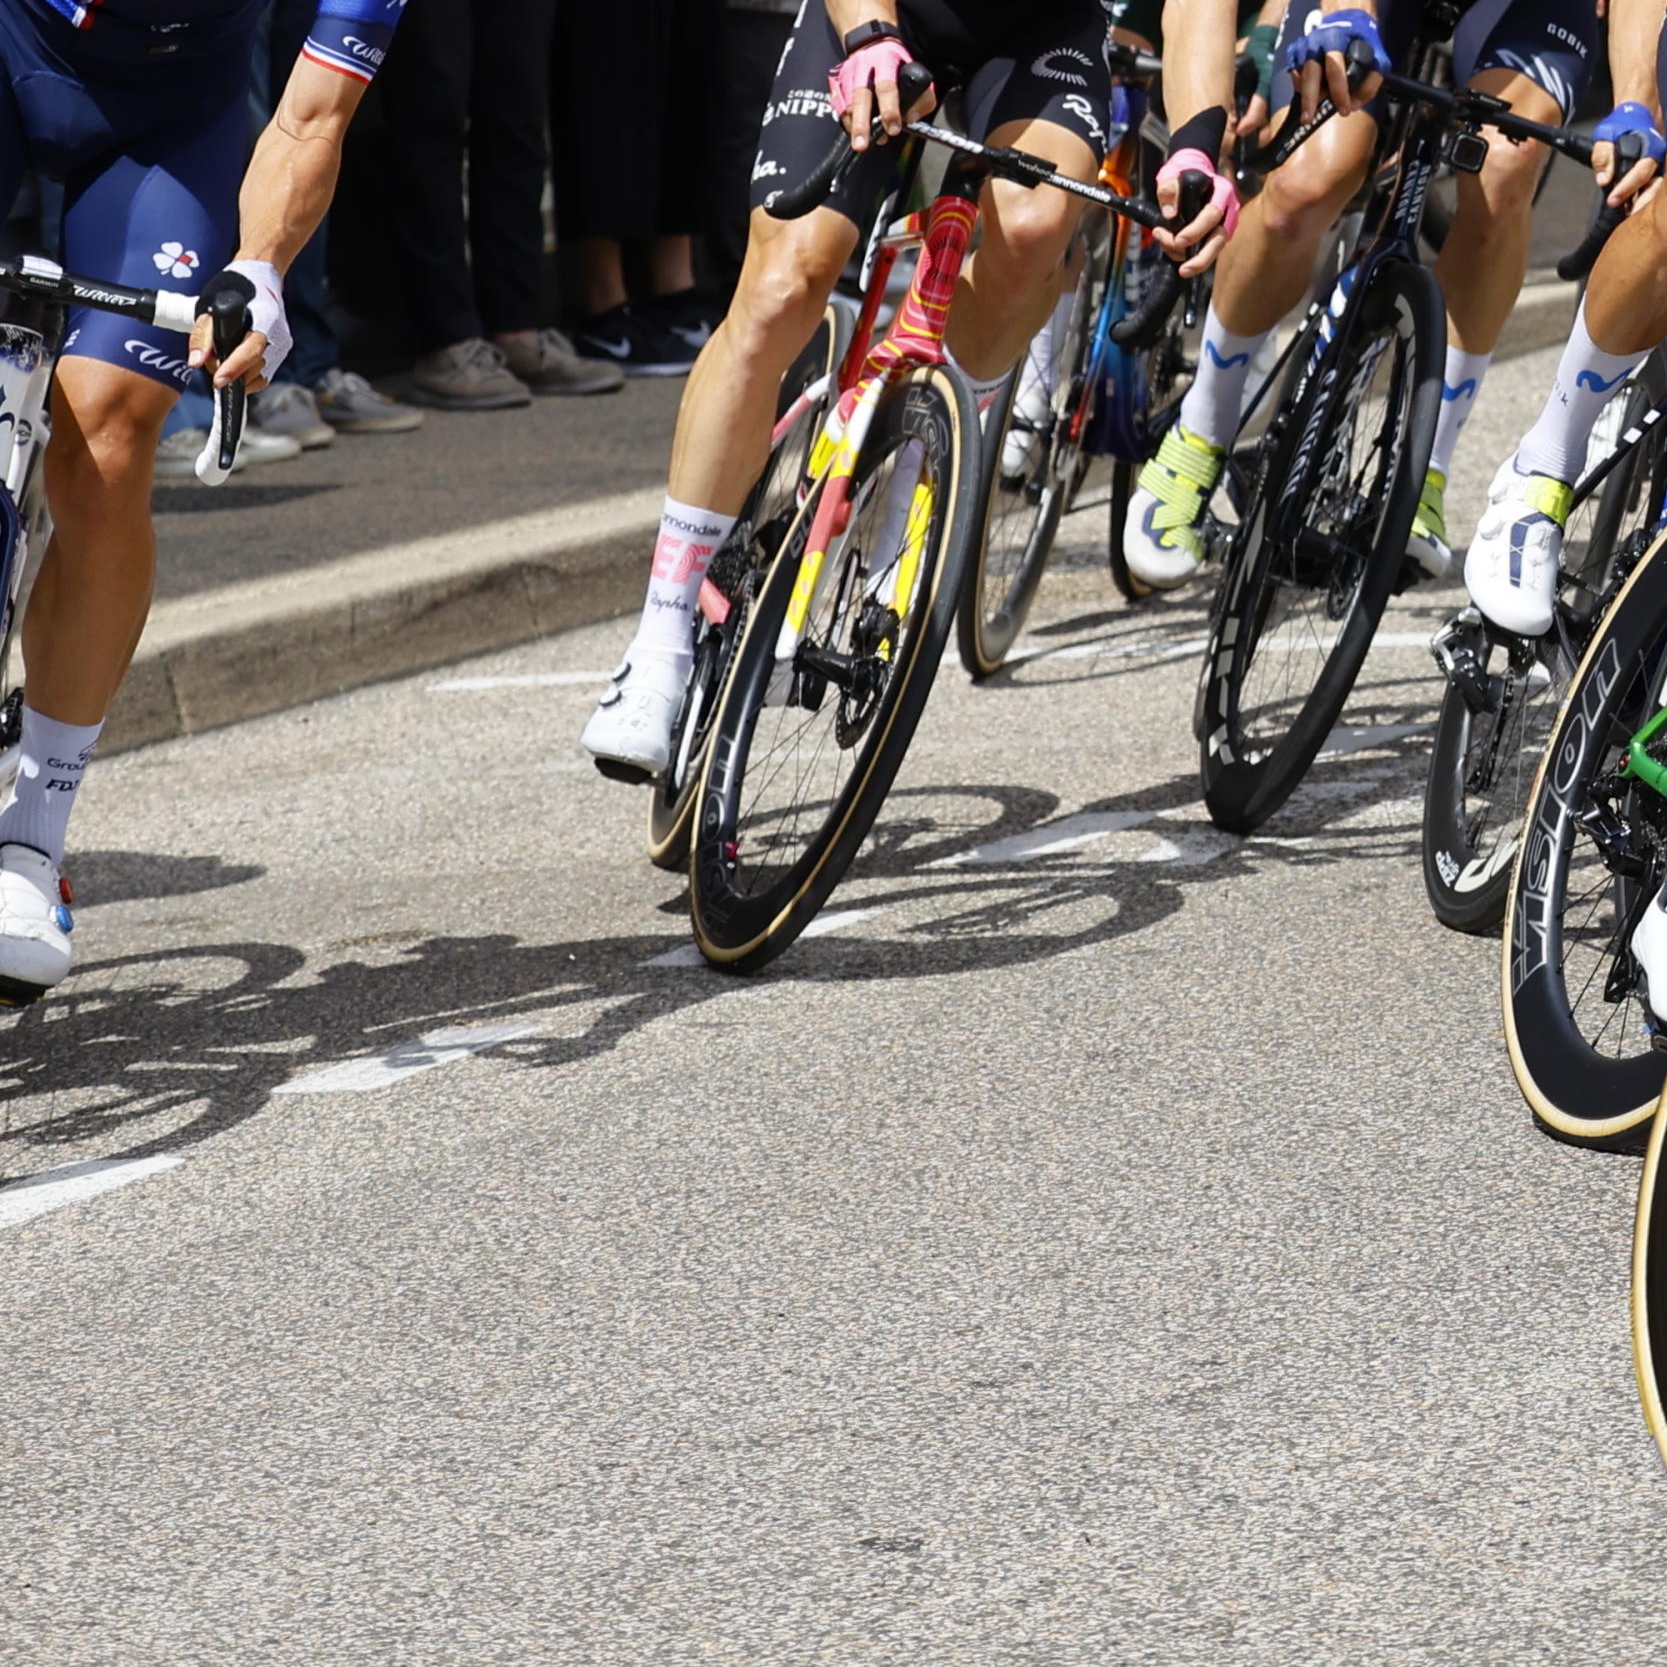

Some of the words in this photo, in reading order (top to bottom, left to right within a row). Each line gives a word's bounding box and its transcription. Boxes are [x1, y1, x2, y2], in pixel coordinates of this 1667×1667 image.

[1061, 94, 1109, 156] Rap
[73, 284, 138, 307] Wilier
[651, 533, 717, 584] EF
[47, 758, 82, 771] Grou
